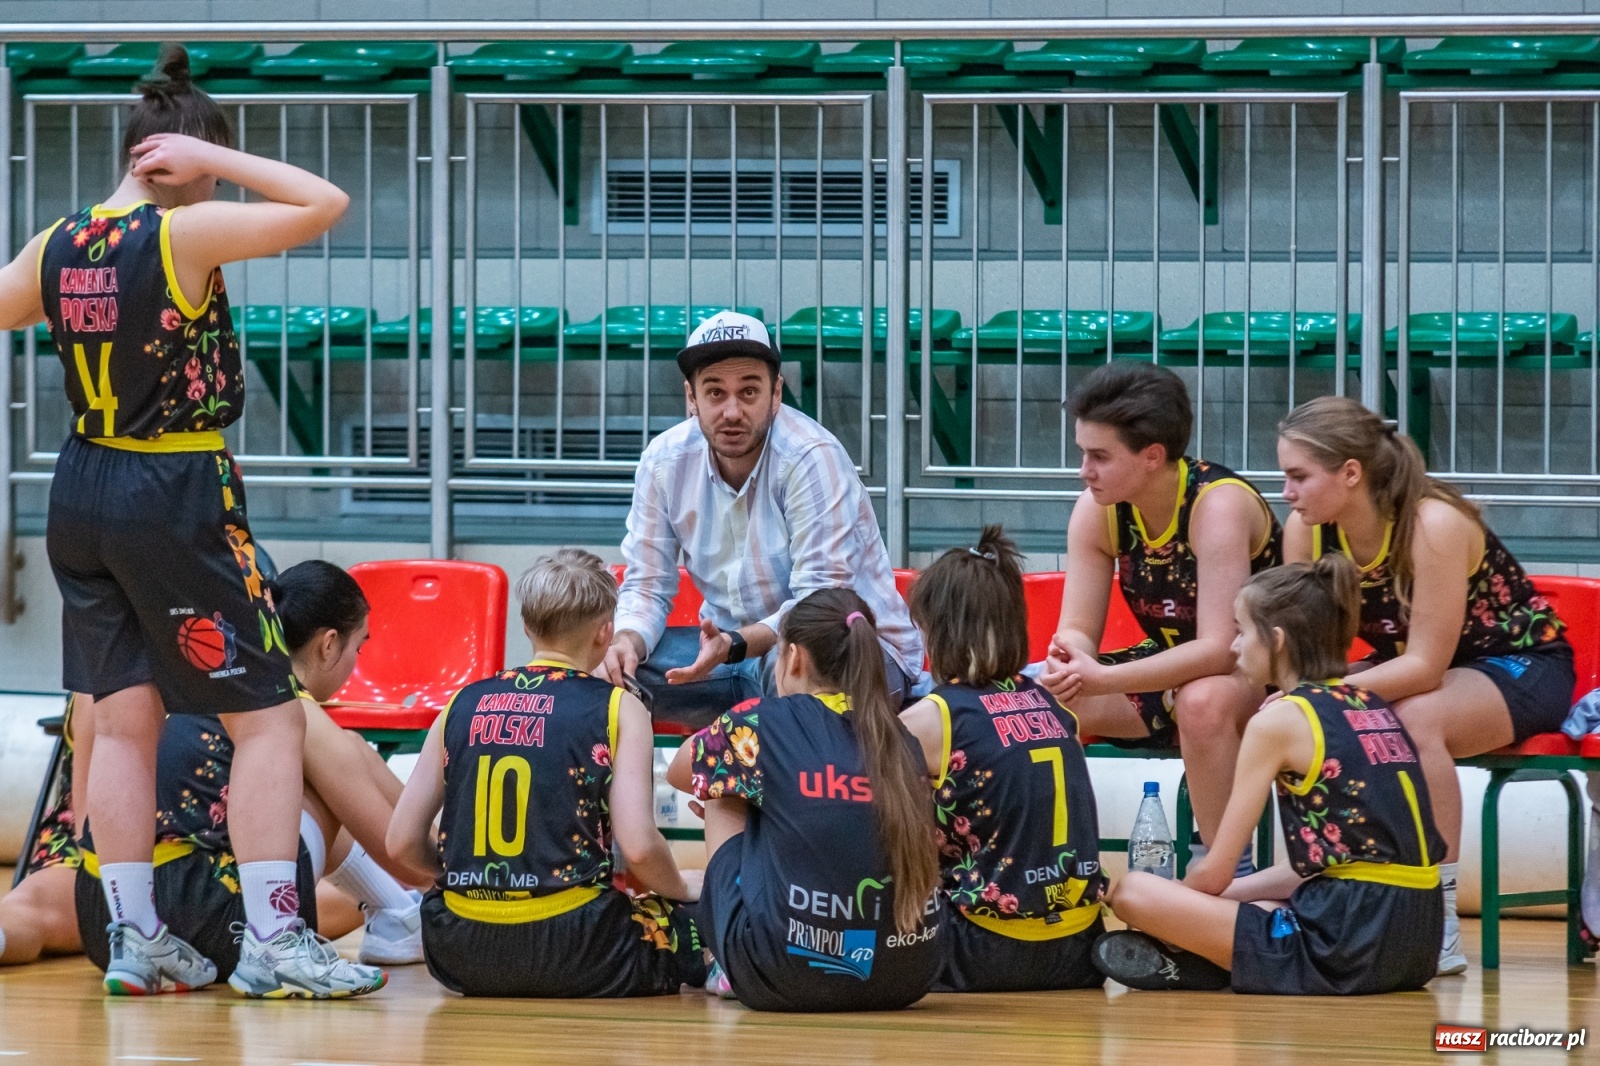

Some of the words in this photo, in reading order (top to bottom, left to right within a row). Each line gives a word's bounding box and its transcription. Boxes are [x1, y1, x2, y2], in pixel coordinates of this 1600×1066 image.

[60, 297, 118, 332] POLSKA
[702, 327, 745, 343] VANS
[475, 692, 554, 714] KAMIENICA
[979, 688, 1051, 714] KAMIENICA
[469, 714, 545, 747] POLSKA
[992, 711, 1069, 748] POLSKA
[799, 764, 873, 802] uks
[1029, 747, 1068, 847] 7
[473, 754, 532, 857] 10
[787, 917, 846, 957] PRiMPOL
